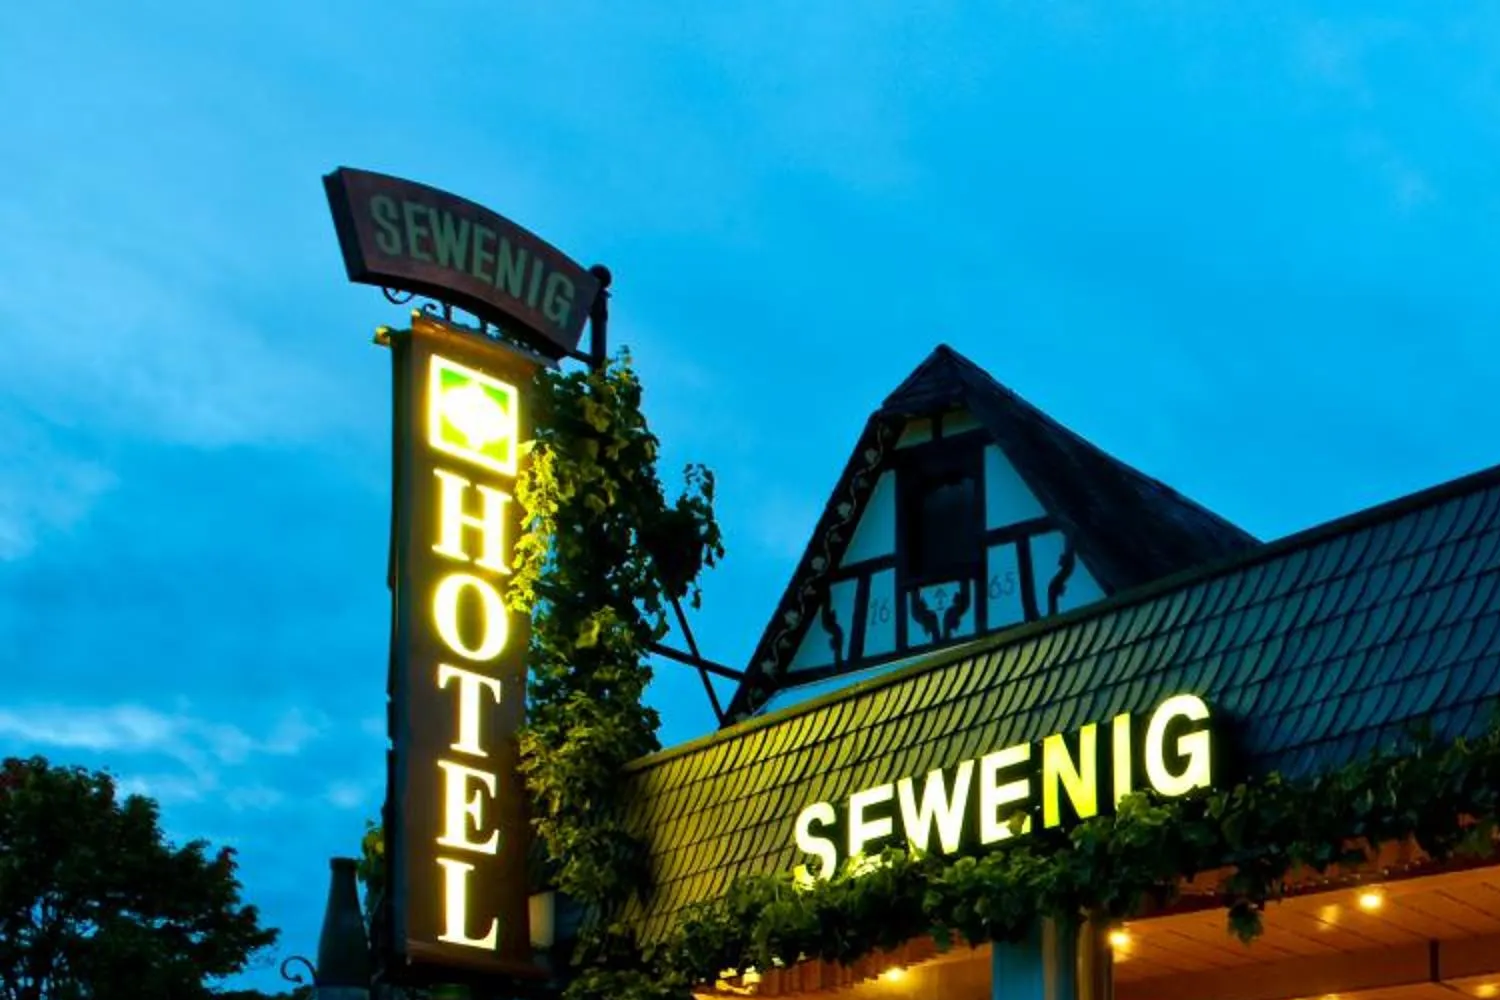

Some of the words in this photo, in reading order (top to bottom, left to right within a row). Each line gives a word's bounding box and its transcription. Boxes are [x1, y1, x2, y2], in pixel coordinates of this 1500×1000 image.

[369, 194, 575, 330] SEWENIG
[431, 468, 512, 951] HOTEL
[792, 693, 1213, 894] SEWENIG
